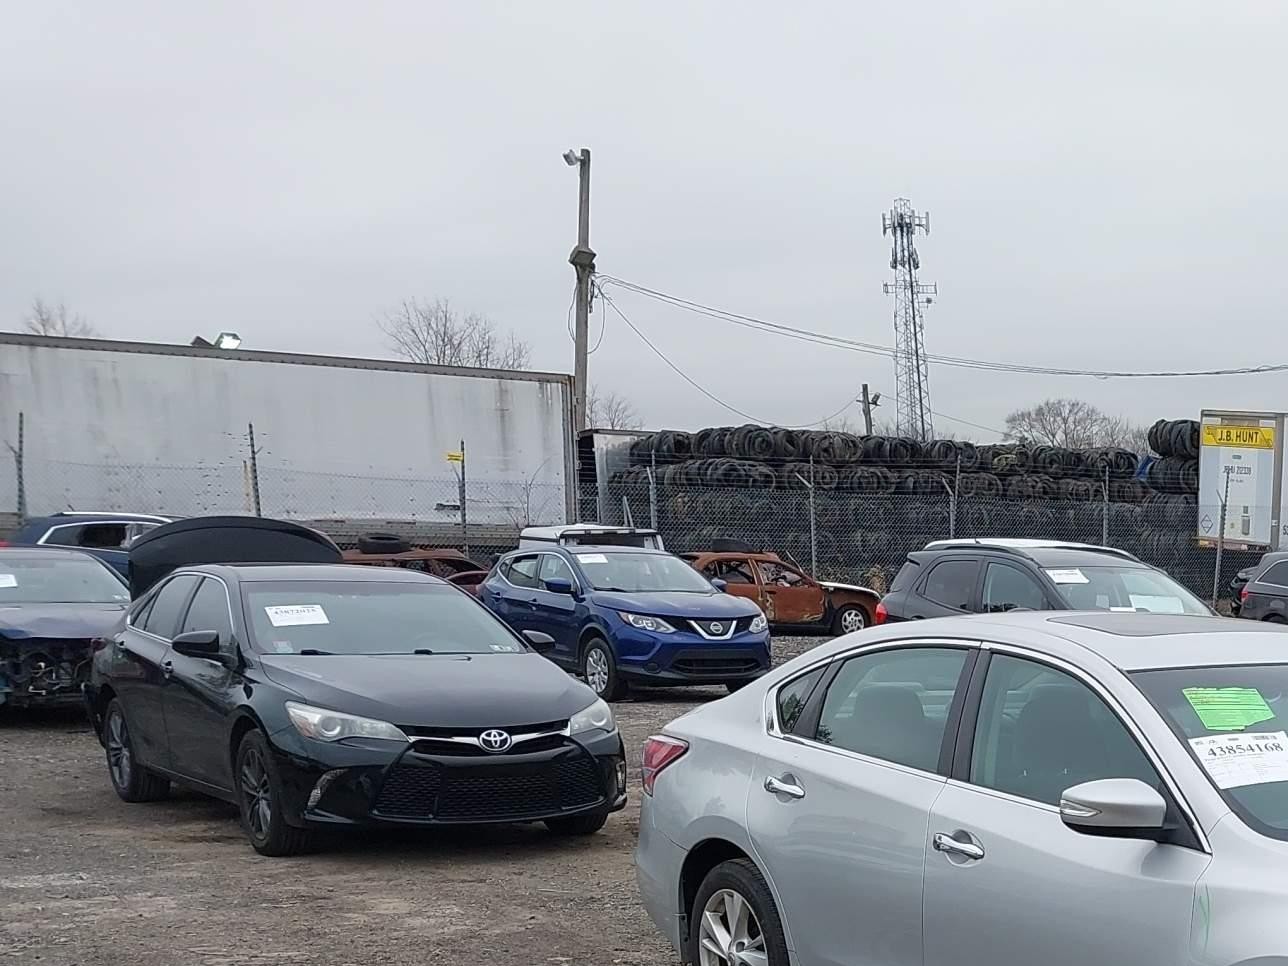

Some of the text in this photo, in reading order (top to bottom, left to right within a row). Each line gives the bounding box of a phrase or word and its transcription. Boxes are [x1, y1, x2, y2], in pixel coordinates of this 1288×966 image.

[1218, 430, 1259, 443] J.B. HUNT
[1207, 742, 1284, 757] 43854168
